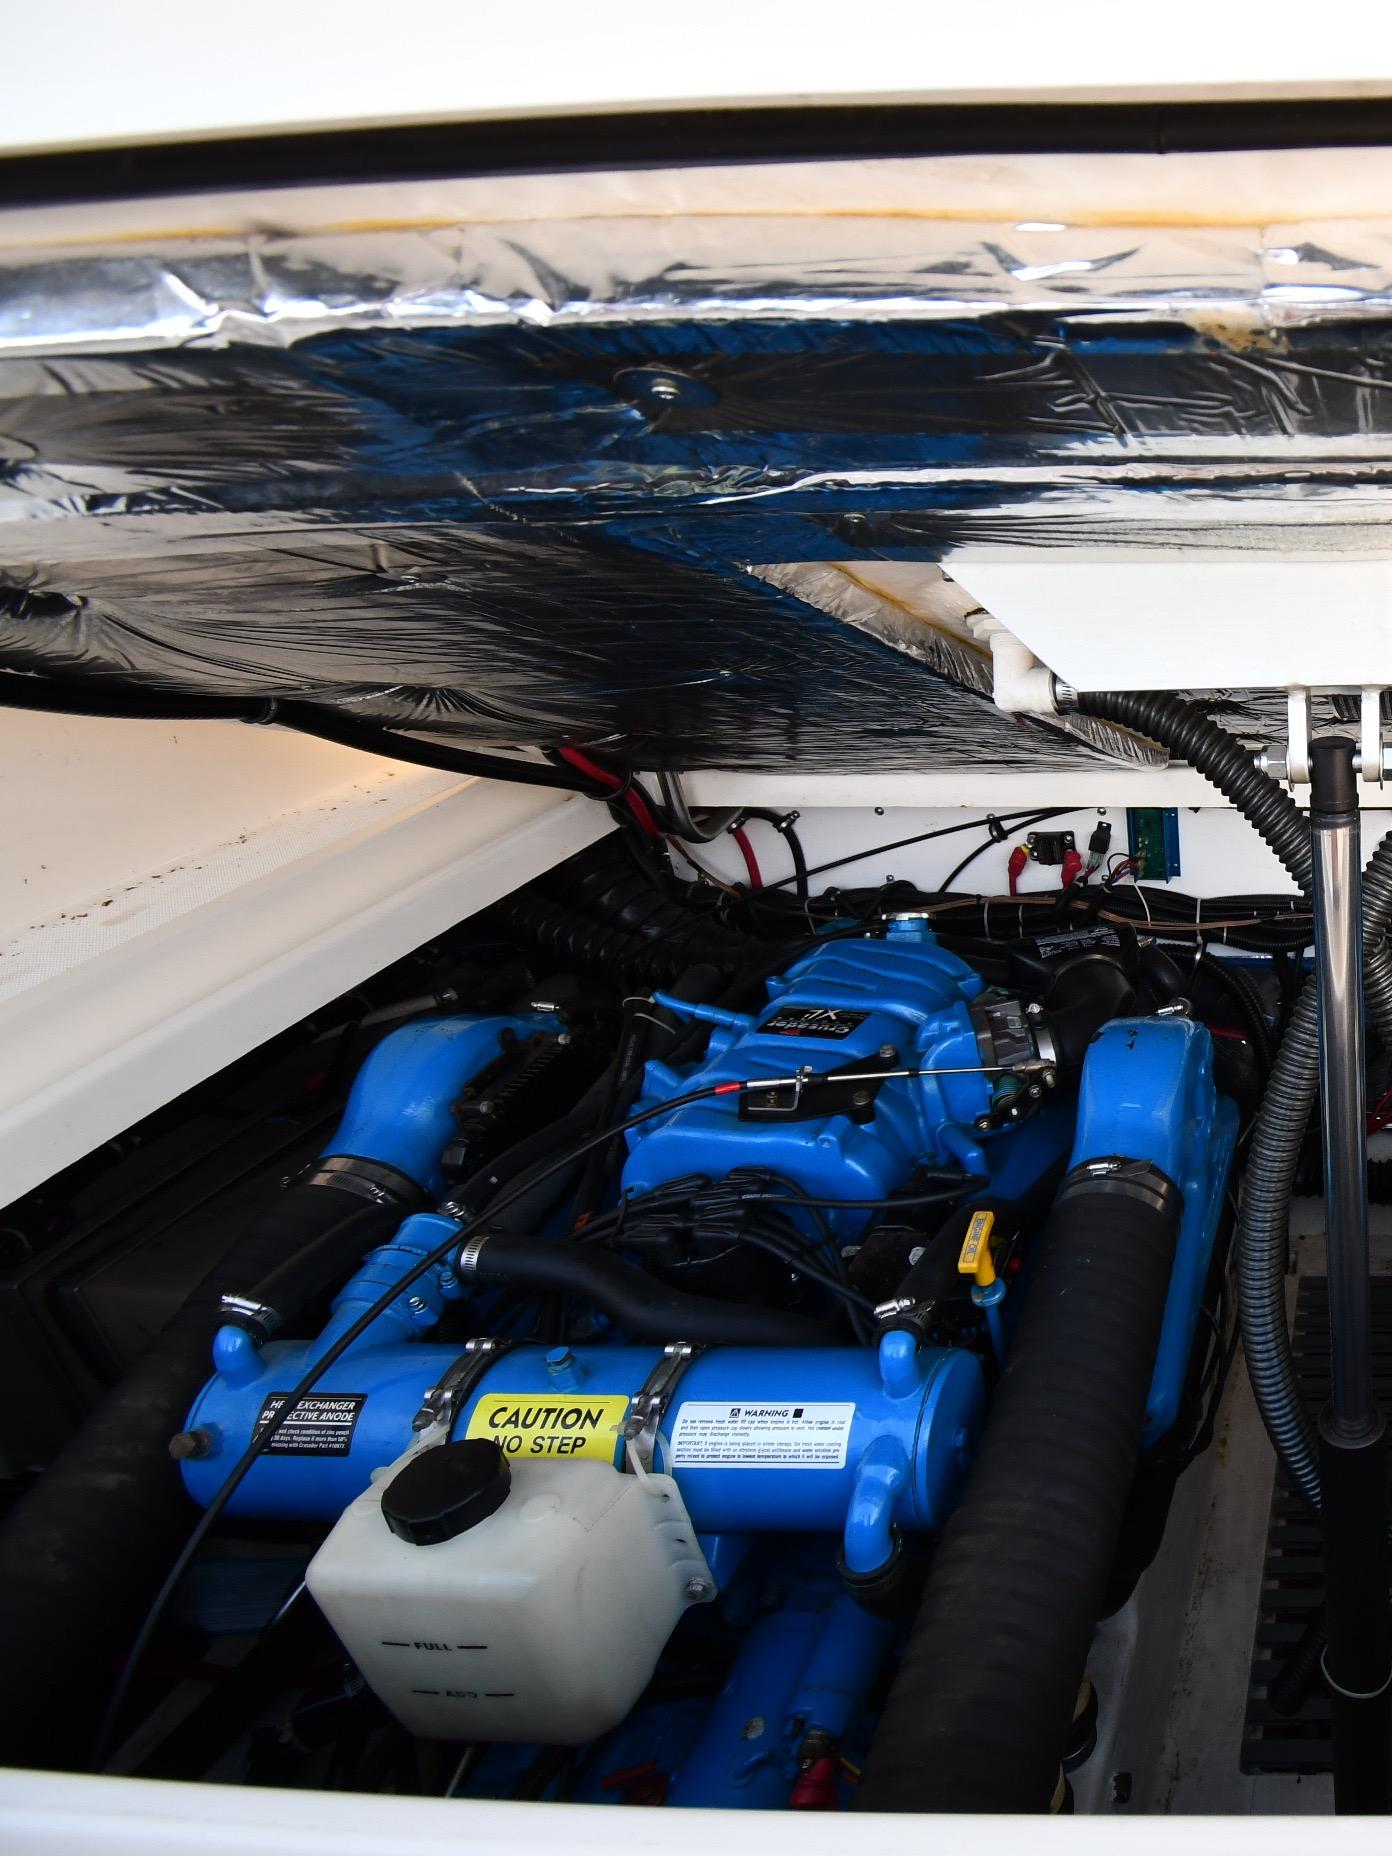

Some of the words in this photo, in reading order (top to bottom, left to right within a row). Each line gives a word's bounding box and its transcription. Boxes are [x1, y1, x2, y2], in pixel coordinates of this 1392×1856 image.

[971, 1218, 985, 1241] ENGINE
[296, 1401, 356, 1410] EXCHANGER
[262, 1411, 320, 1421] PRECTIVE
[320, 1412, 355, 1422] ANODE
[488, 1406, 604, 1430] CAUTION
[744, 1410, 790, 1418] WARNING
[494, 1435, 522, 1454] NO
[530, 1436, 586, 1454] STEP
[414, 1642, 452, 1651] FULL
